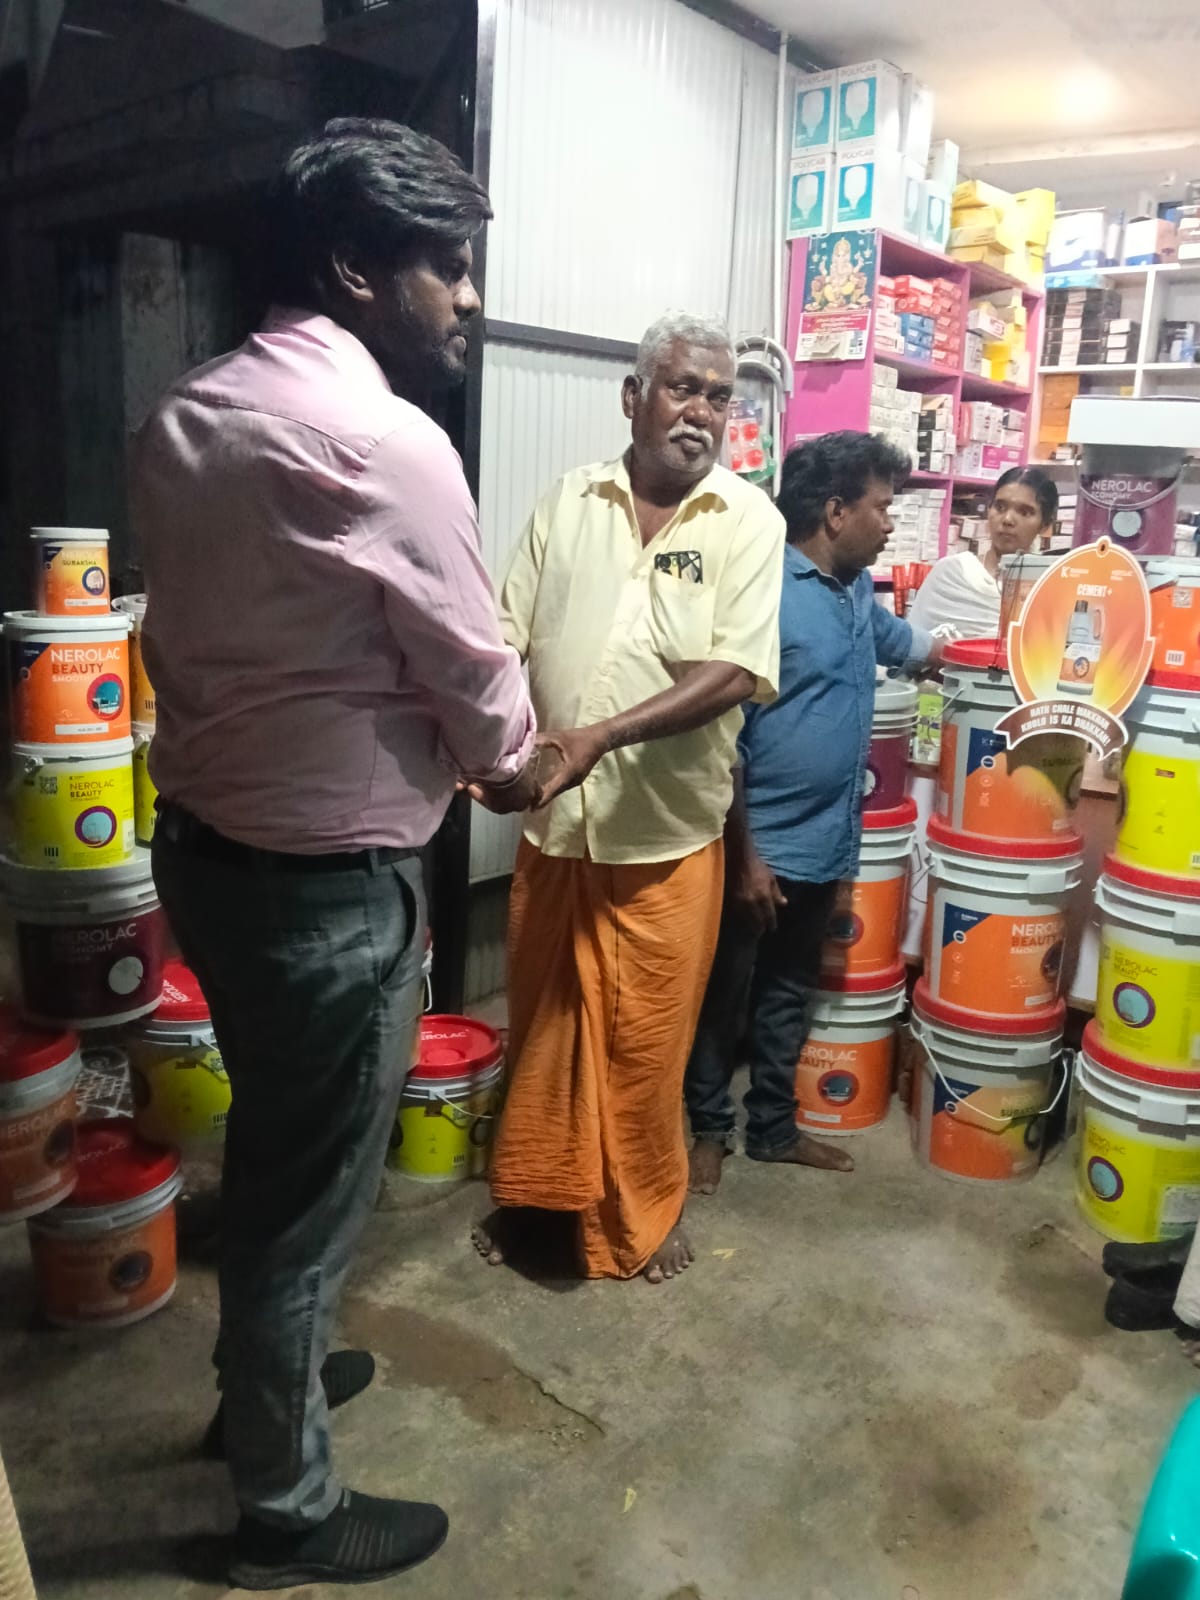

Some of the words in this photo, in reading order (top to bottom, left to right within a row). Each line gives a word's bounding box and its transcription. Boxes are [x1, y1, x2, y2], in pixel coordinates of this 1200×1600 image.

[1091, 479, 1153, 493] NEROLAC
[50, 647, 121, 663] NEROLAC
[52, 663, 104, 675] BEAUTY
[69, 778, 115, 791] NEROLAC
[69, 789, 102, 798] BEAUTY
[800, 1045, 858, 1062] EROLAC
[1, 1100, 68, 1139] EROLAC
